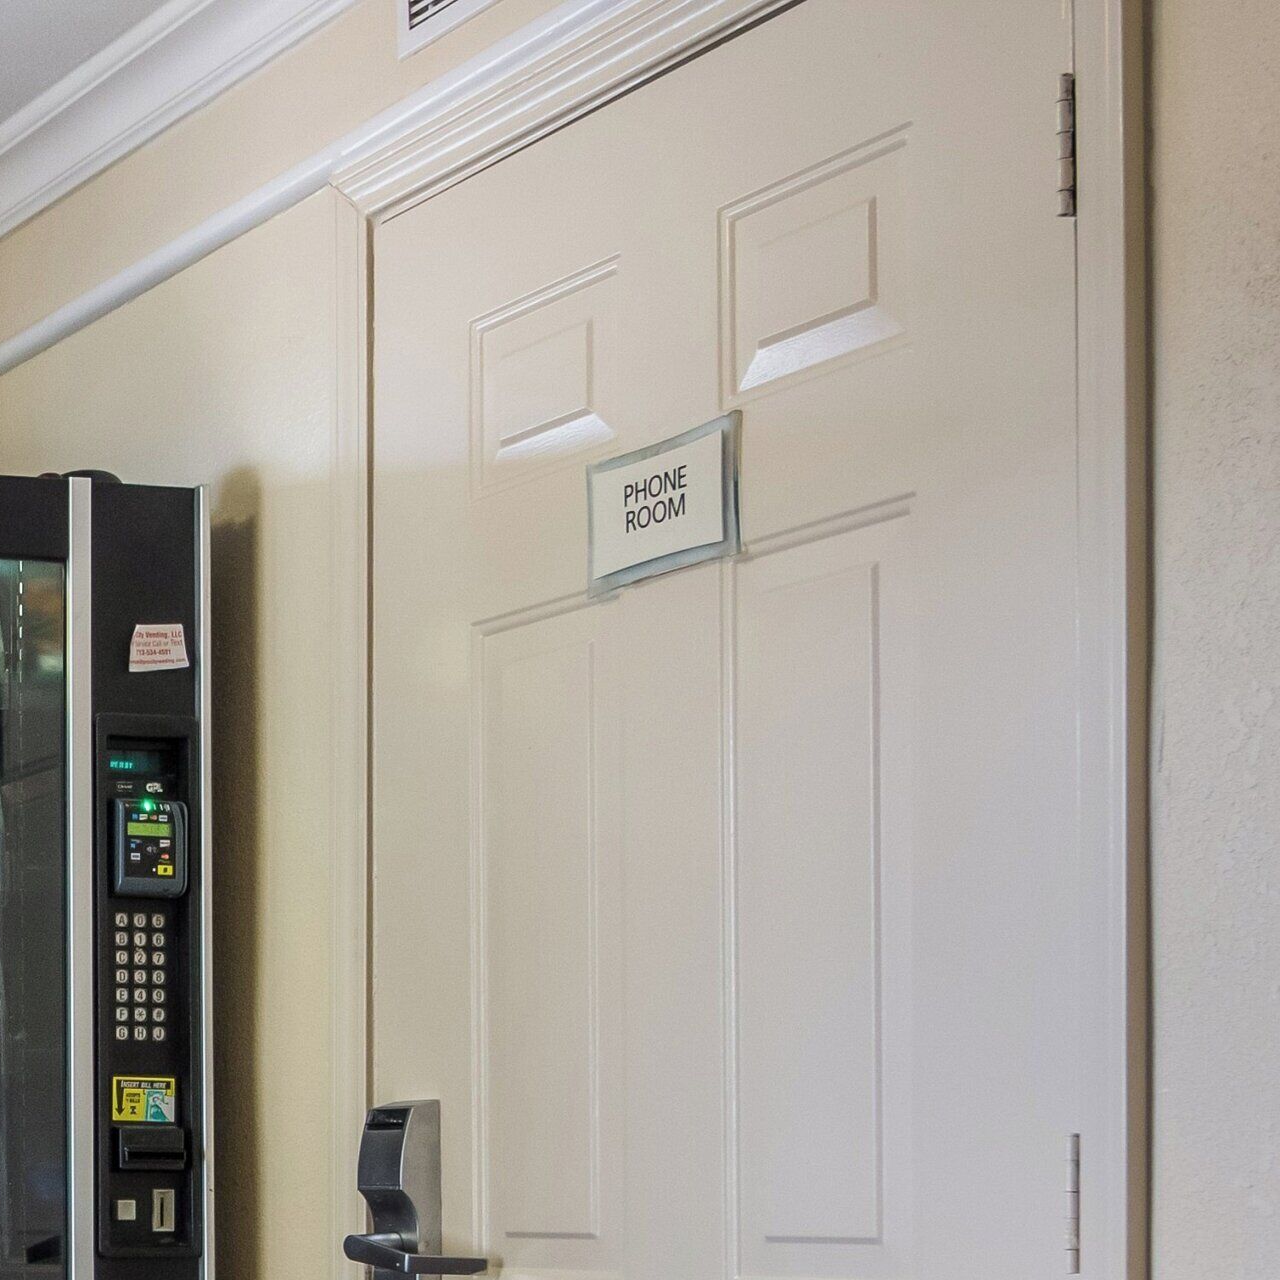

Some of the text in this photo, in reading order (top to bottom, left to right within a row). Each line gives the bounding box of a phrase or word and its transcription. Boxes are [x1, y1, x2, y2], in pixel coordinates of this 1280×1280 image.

[624, 465, 687, 508] PHONE
[626, 493, 685, 533] ROOM
[121, 1080, 139, 1088] INSERT
